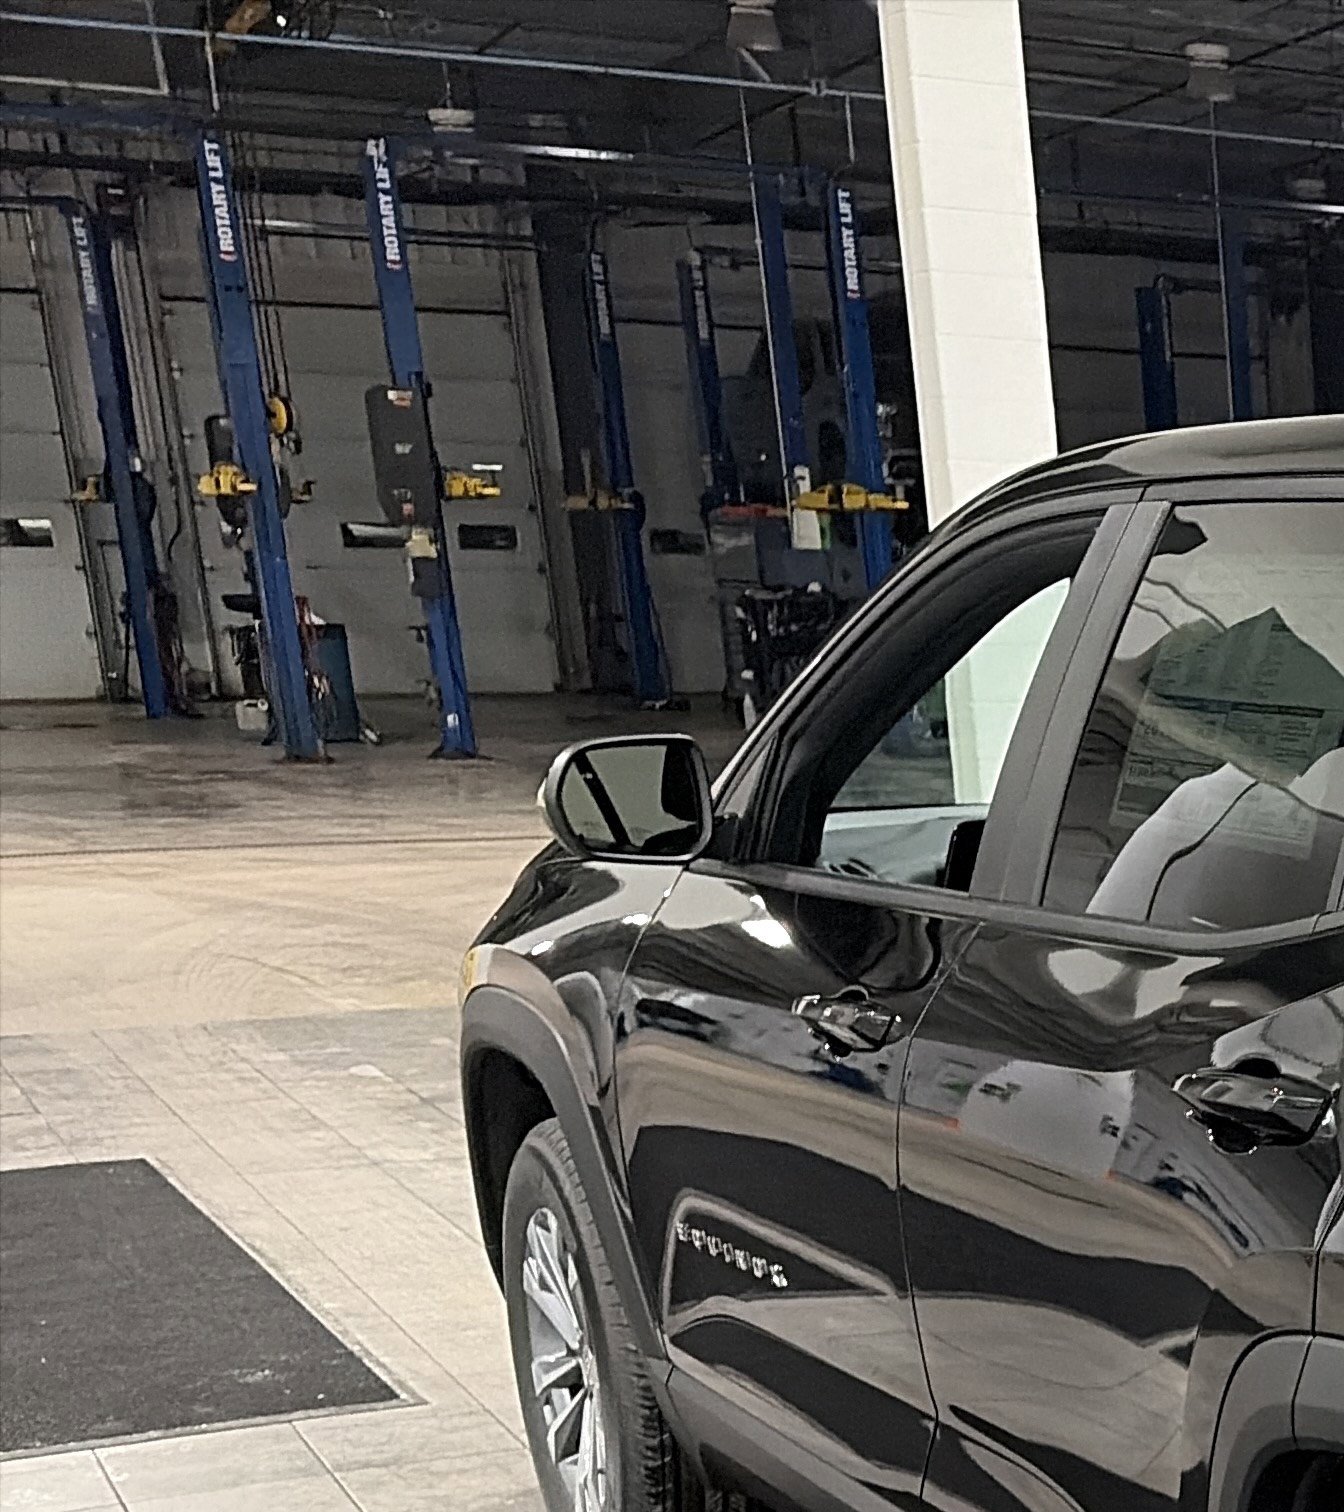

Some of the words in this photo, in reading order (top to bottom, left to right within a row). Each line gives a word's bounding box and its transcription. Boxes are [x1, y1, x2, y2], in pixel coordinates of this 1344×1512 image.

[203, 139, 224, 178] LIFT
[209, 181, 235, 252] ROTARY
[378, 192, 401, 261] ROTARY
